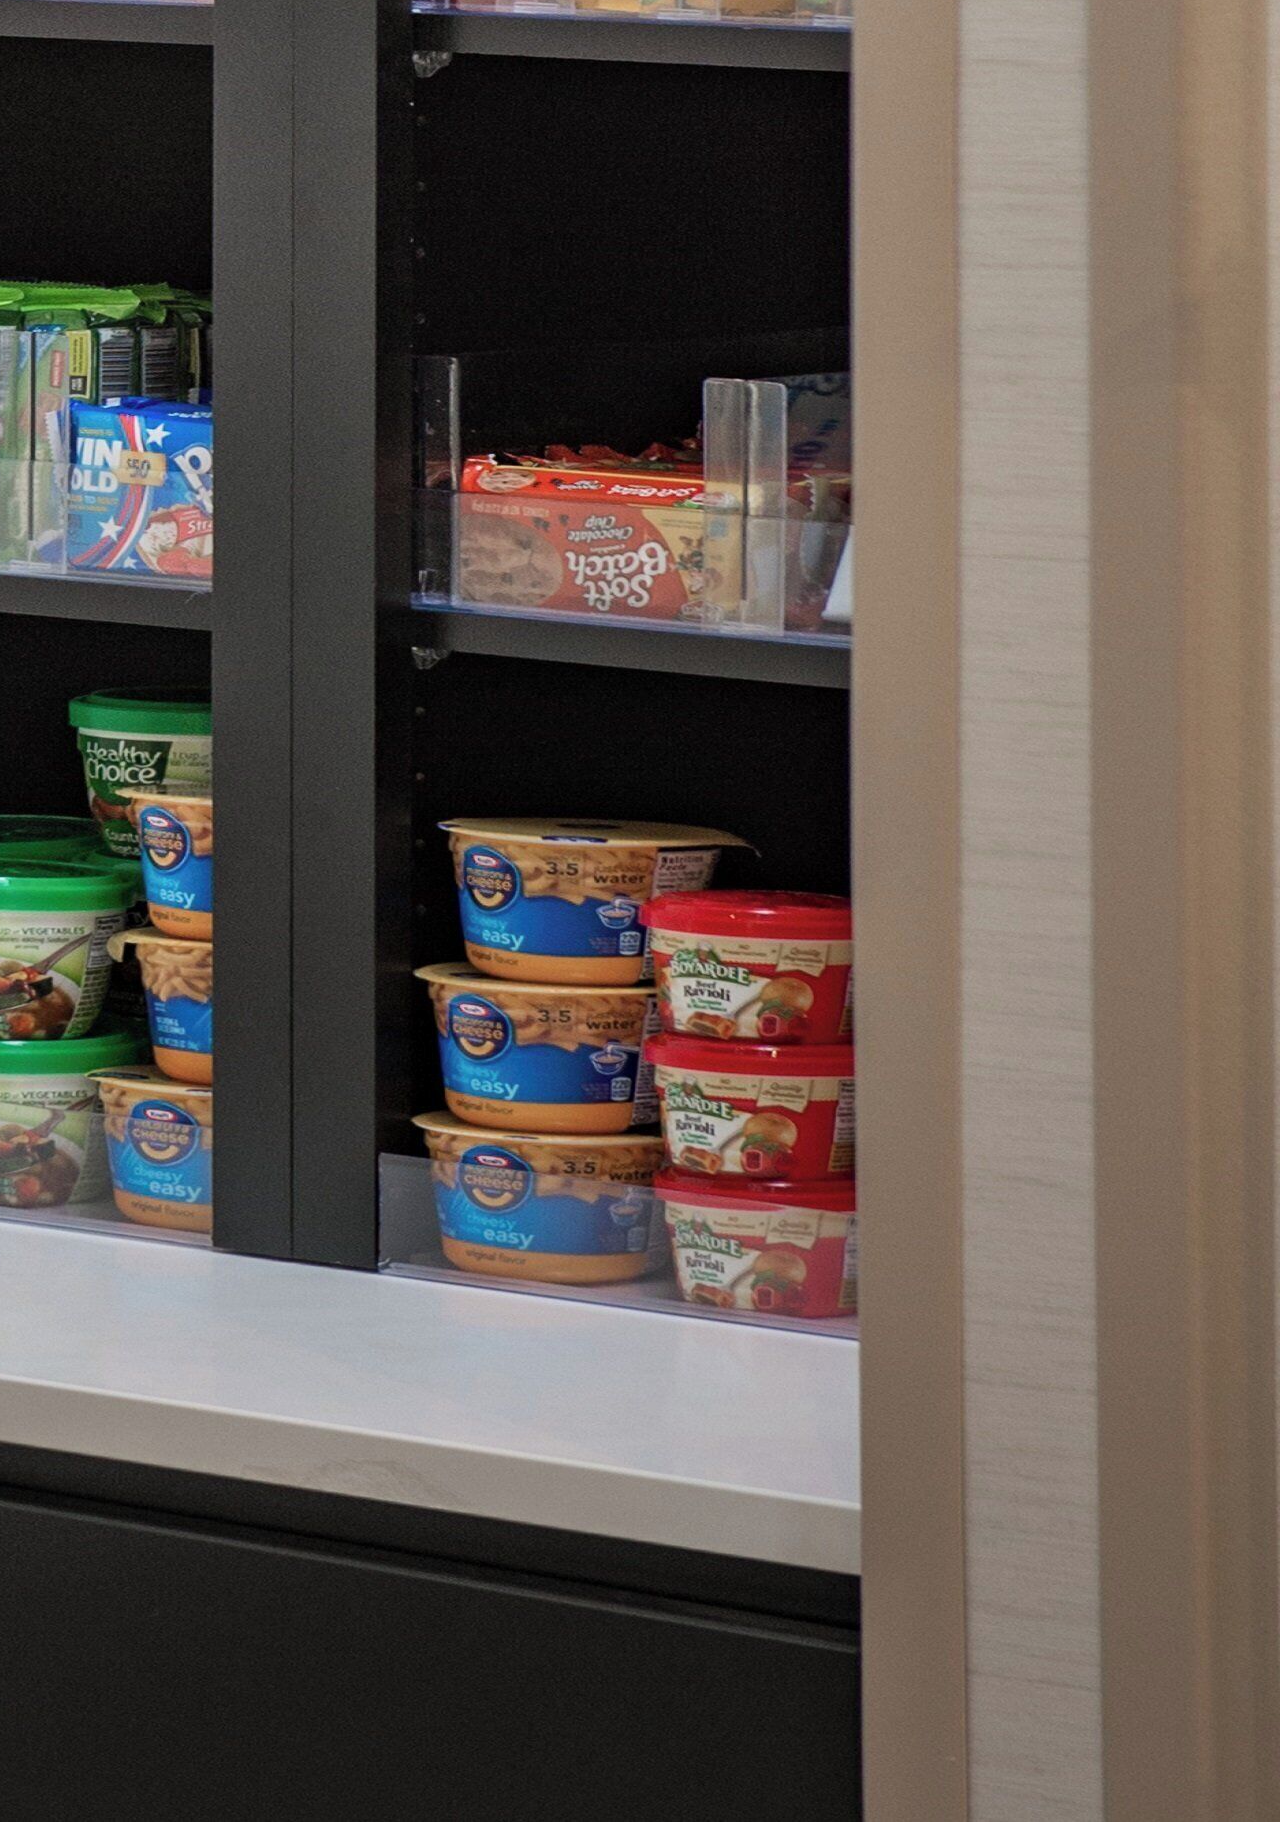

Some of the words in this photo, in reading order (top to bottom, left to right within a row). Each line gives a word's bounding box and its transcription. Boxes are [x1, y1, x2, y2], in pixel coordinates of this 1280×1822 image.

[71, 471, 118, 493] OLD
[584, 514, 616, 529] Chip
[567, 525, 633, 545] Chocolate
[565, 541, 669, 585] Batch
[583, 573, 651, 612] Soft
[86, 740, 162, 768] Healthy
[86, 759, 157, 784] Choice
[546, 862, 579, 876] 3.5
[593, 873, 646, 884] water
[159, 888, 196, 909] easy
[22, 927, 85, 935] VEGETABLES
[482, 929, 524, 950] easy
[670, 959, 751, 984] BOYARDEE
[684, 986, 731, 1002] Ravioli
[696, 980, 716, 989] Beef
[537, 1009, 571, 1023] 3.5
[586, 1019, 638, 1030] water
[21, 1090, 87, 1099] VEGETABLES
[470, 1078, 519, 1100] easy
[563, 1161, 596, 1175] 3.5
[149, 1179, 202, 1202] easy
[483, 1228, 534, 1250] easy
